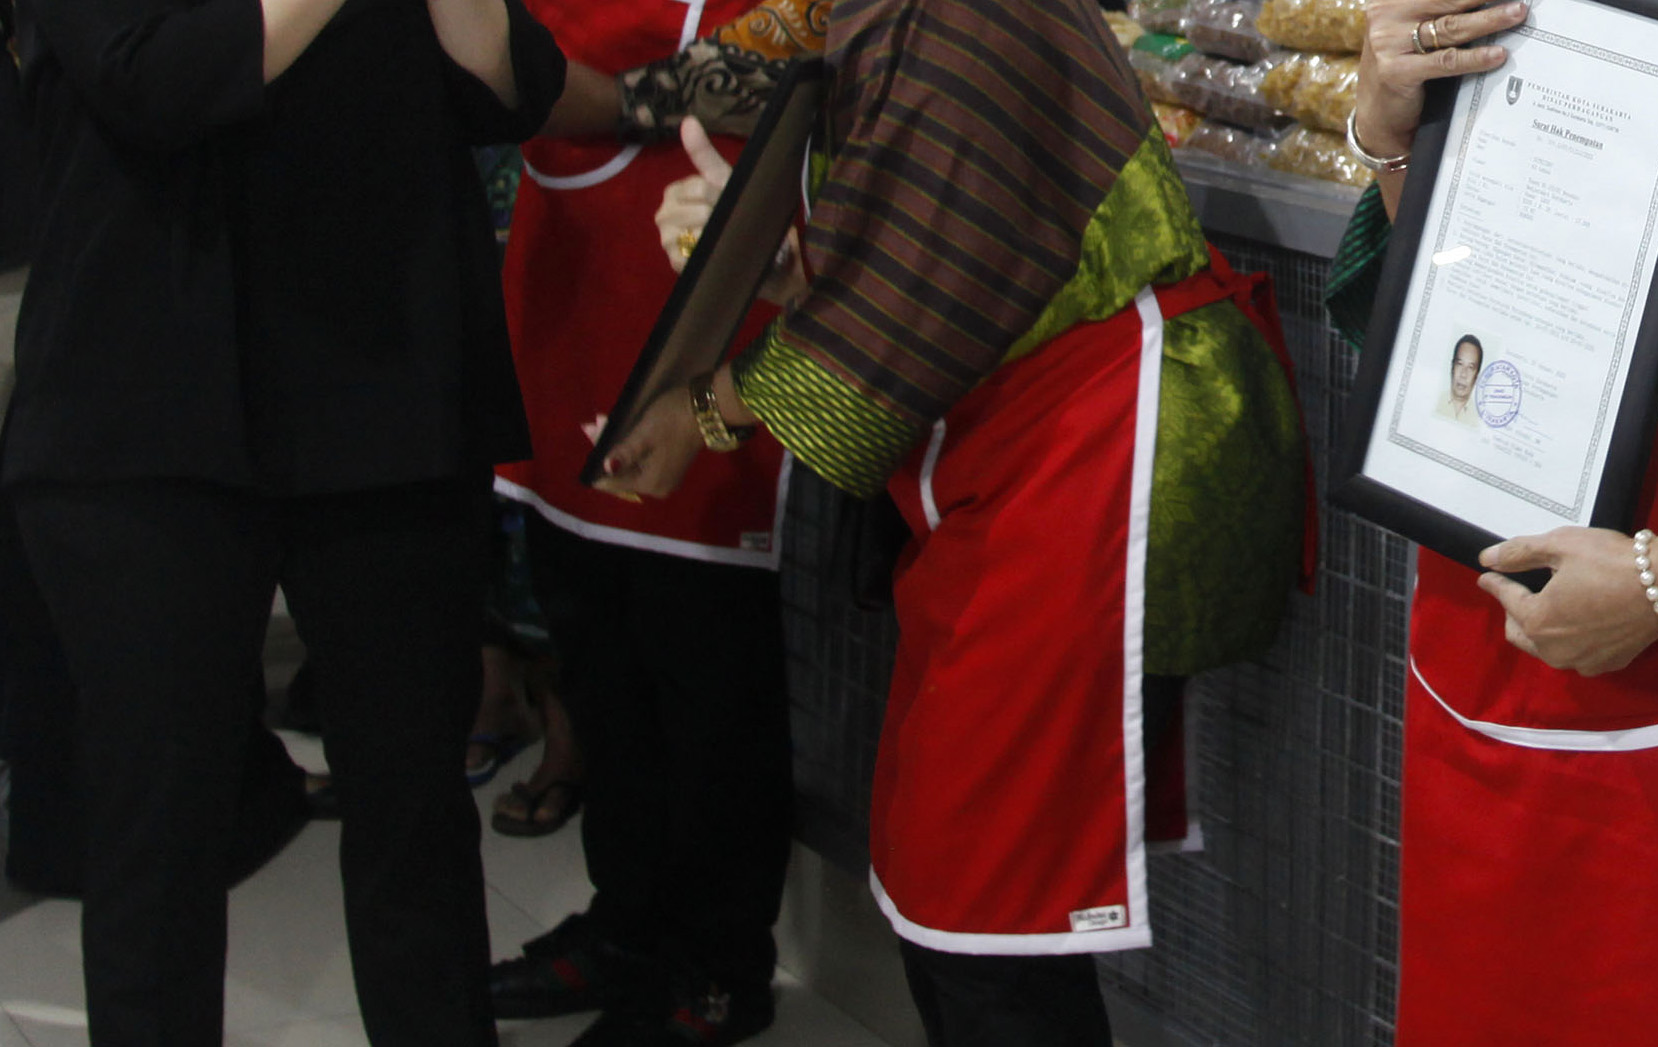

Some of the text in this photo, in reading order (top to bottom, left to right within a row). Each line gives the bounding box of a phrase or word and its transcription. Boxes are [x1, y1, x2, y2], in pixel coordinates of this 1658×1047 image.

[1572, 96, 1590, 108] KOTA
[1532, 118, 1550, 132] Surat
[1550, 123, 1564, 137] Hak
[1564, 128, 1604, 150] Penempatan
